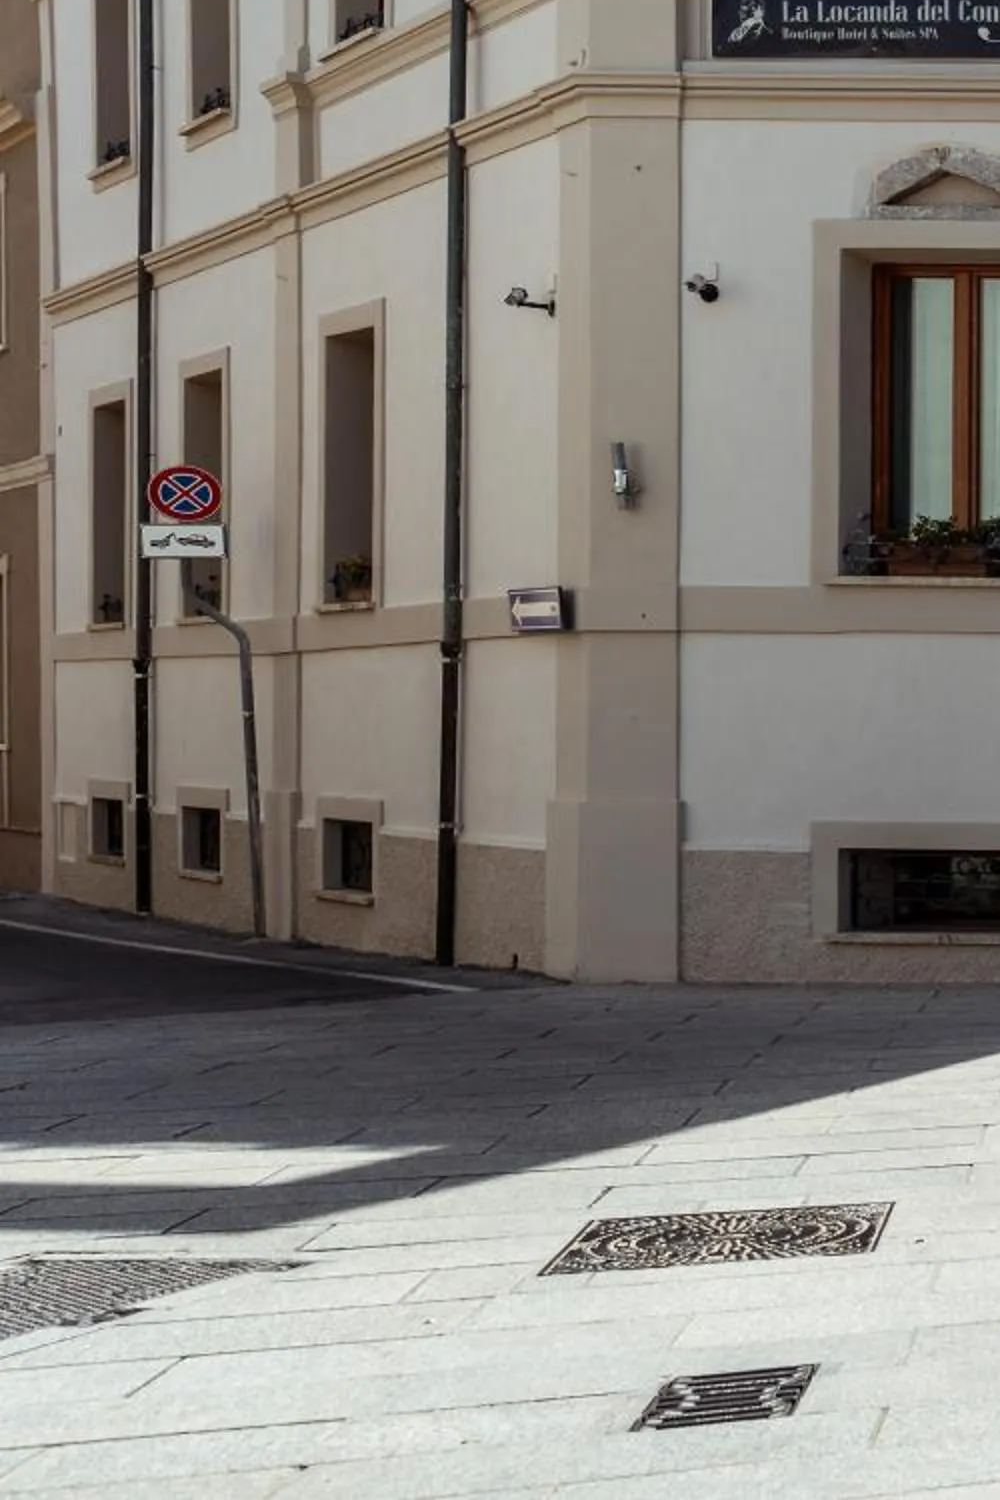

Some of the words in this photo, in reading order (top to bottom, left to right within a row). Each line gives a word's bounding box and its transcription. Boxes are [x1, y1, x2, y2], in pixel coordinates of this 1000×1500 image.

[782, 0, 809, 23] La
[782, 27, 834, 44] Boutique
[837, 27, 867, 41] Hotel
